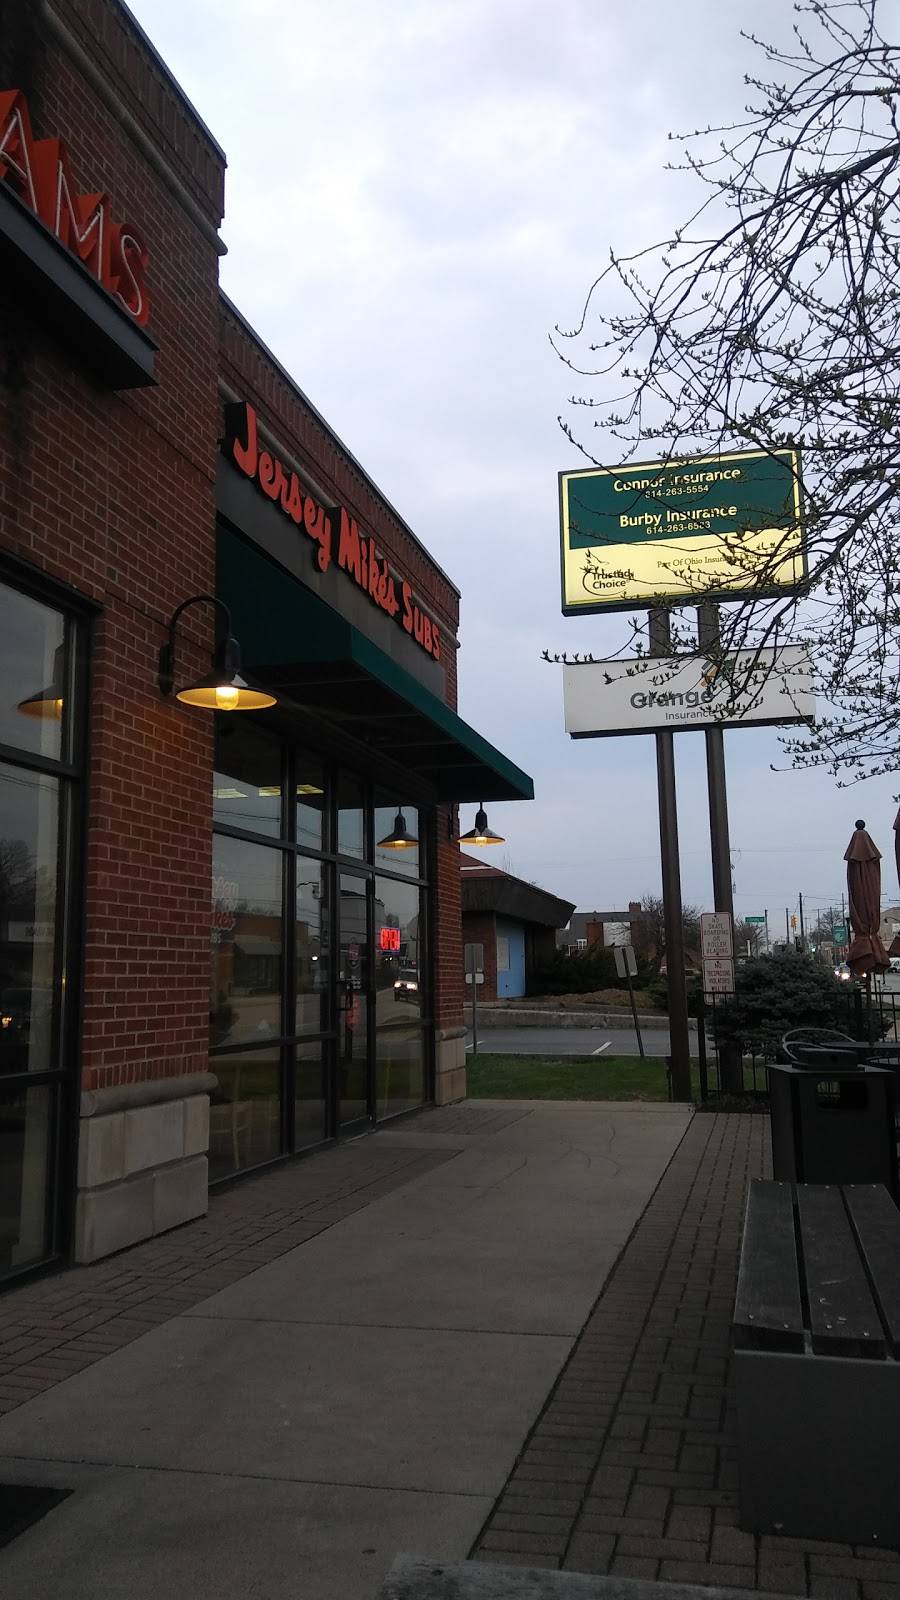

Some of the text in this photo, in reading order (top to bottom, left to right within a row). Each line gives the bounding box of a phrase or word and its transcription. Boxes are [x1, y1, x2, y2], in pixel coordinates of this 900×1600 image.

[613, 476, 666, 492] Connor
[232, 402, 332, 573] Jersey
[337, 506, 400, 617] Mike's
[620, 505, 738, 528] Burby Insurance
[657, 560, 671, 568] Prt
[673, 558, 683, 567] Of
[684, 557, 703, 566] Ohio
[592, 579, 627, 590] Choice
[630, 691, 714, 709] Grange
[665, 710, 714, 720] Insurance
